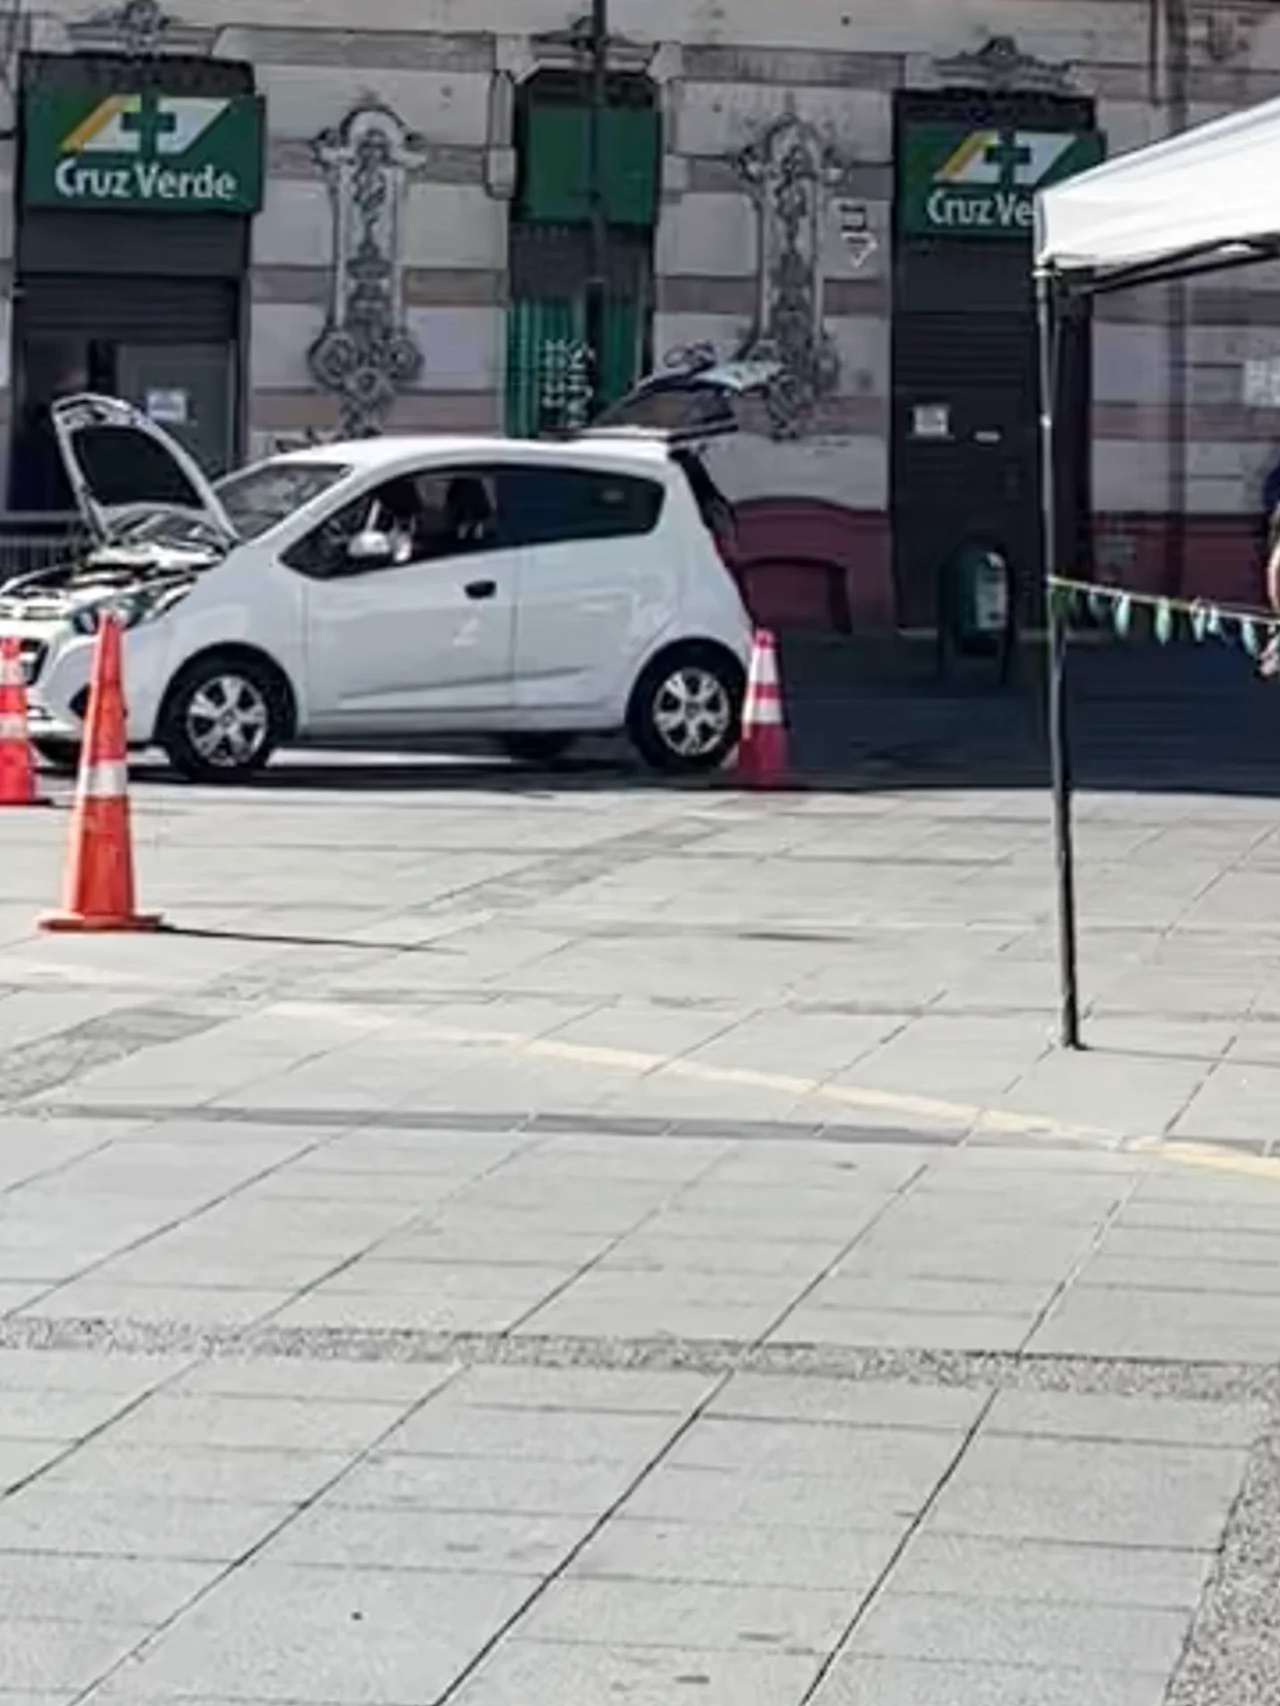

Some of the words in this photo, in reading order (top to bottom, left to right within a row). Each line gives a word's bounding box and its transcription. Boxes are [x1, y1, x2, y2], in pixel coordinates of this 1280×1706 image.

[54, 157, 130, 198] Cruz
[133, 159, 237, 200] Verde
[926, 190, 993, 225] Cruz
